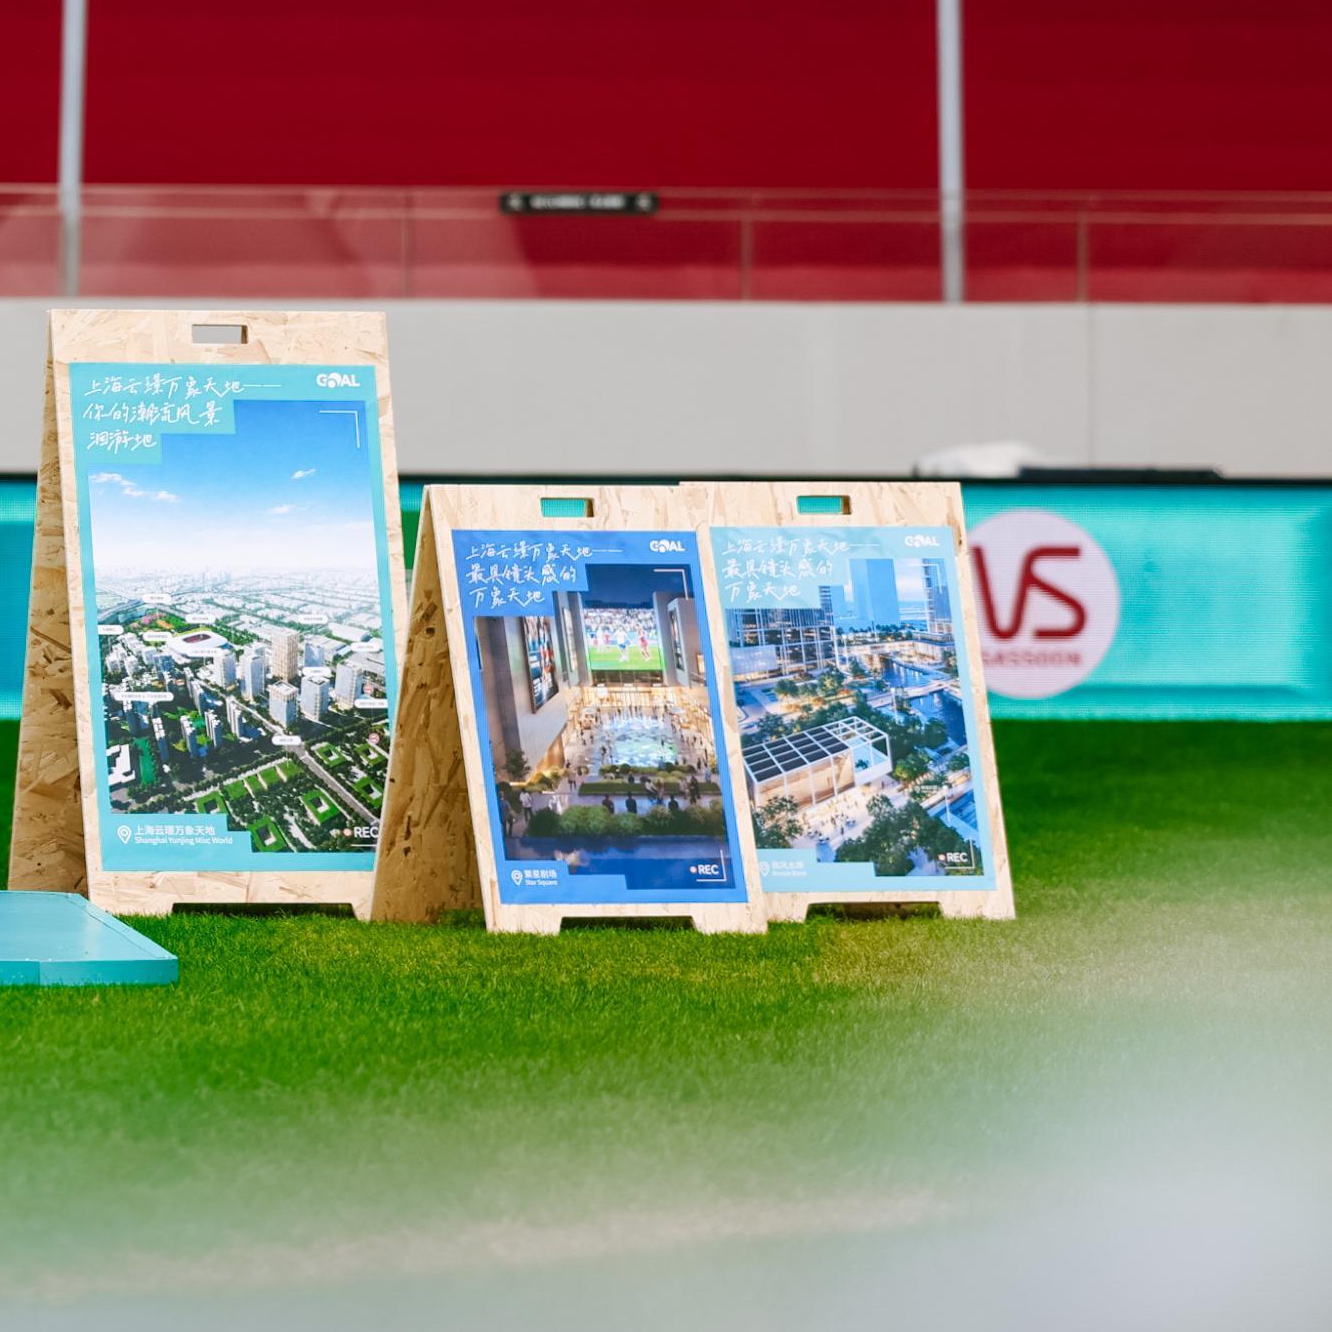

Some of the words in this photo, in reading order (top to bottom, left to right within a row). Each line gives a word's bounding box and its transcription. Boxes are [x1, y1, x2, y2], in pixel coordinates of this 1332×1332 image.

[316, 372, 360, 388] GOAL
[650, 539, 685, 553] GOAL
[469, 586, 545, 609] 万象天地
[971, 545, 1088, 641] VS
[946, 852, 968, 862] REC
[698, 864, 720, 875] REC
